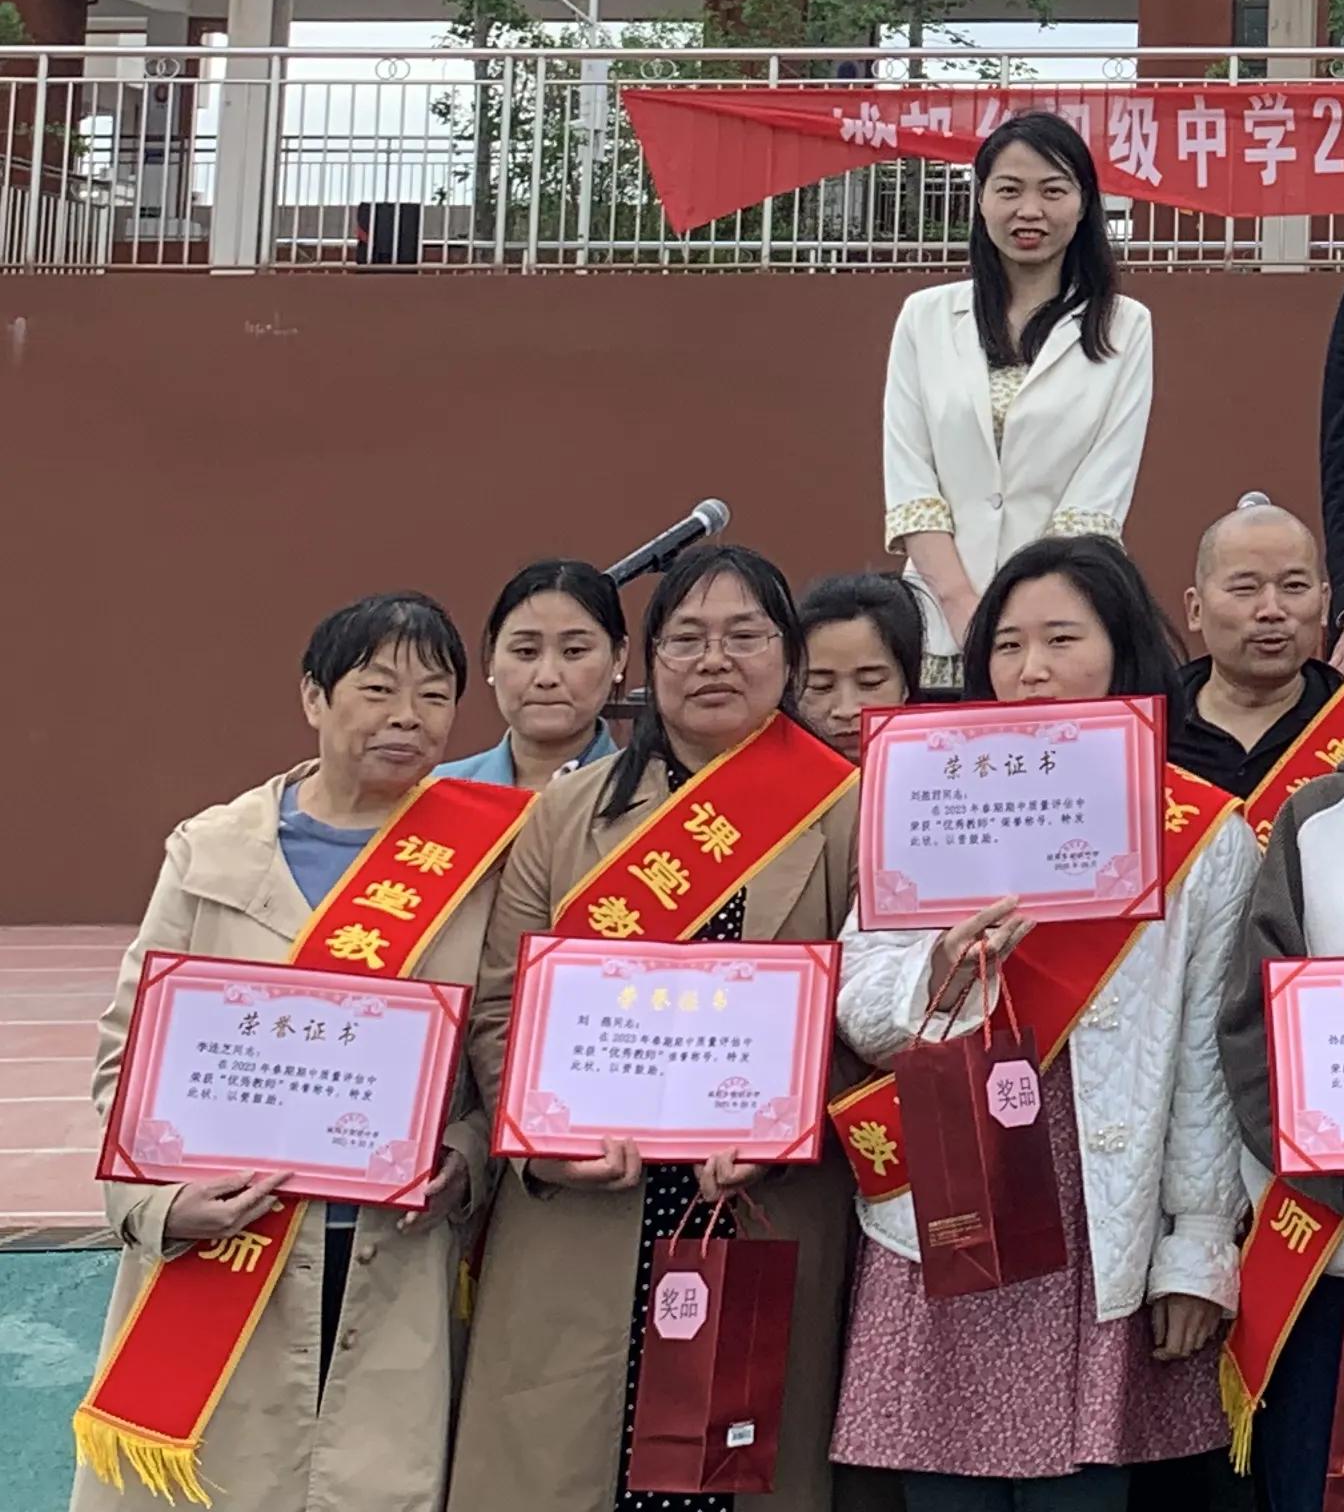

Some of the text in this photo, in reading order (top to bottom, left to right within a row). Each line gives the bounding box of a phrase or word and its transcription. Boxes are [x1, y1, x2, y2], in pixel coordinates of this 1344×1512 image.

[944, 750, 1056, 780] 荣誉证书
[238, 1011, 360, 1046] 荣誉证书
[997, 1076, 1036, 1112] 奖品
[659, 1287, 699, 1320] 奖品
